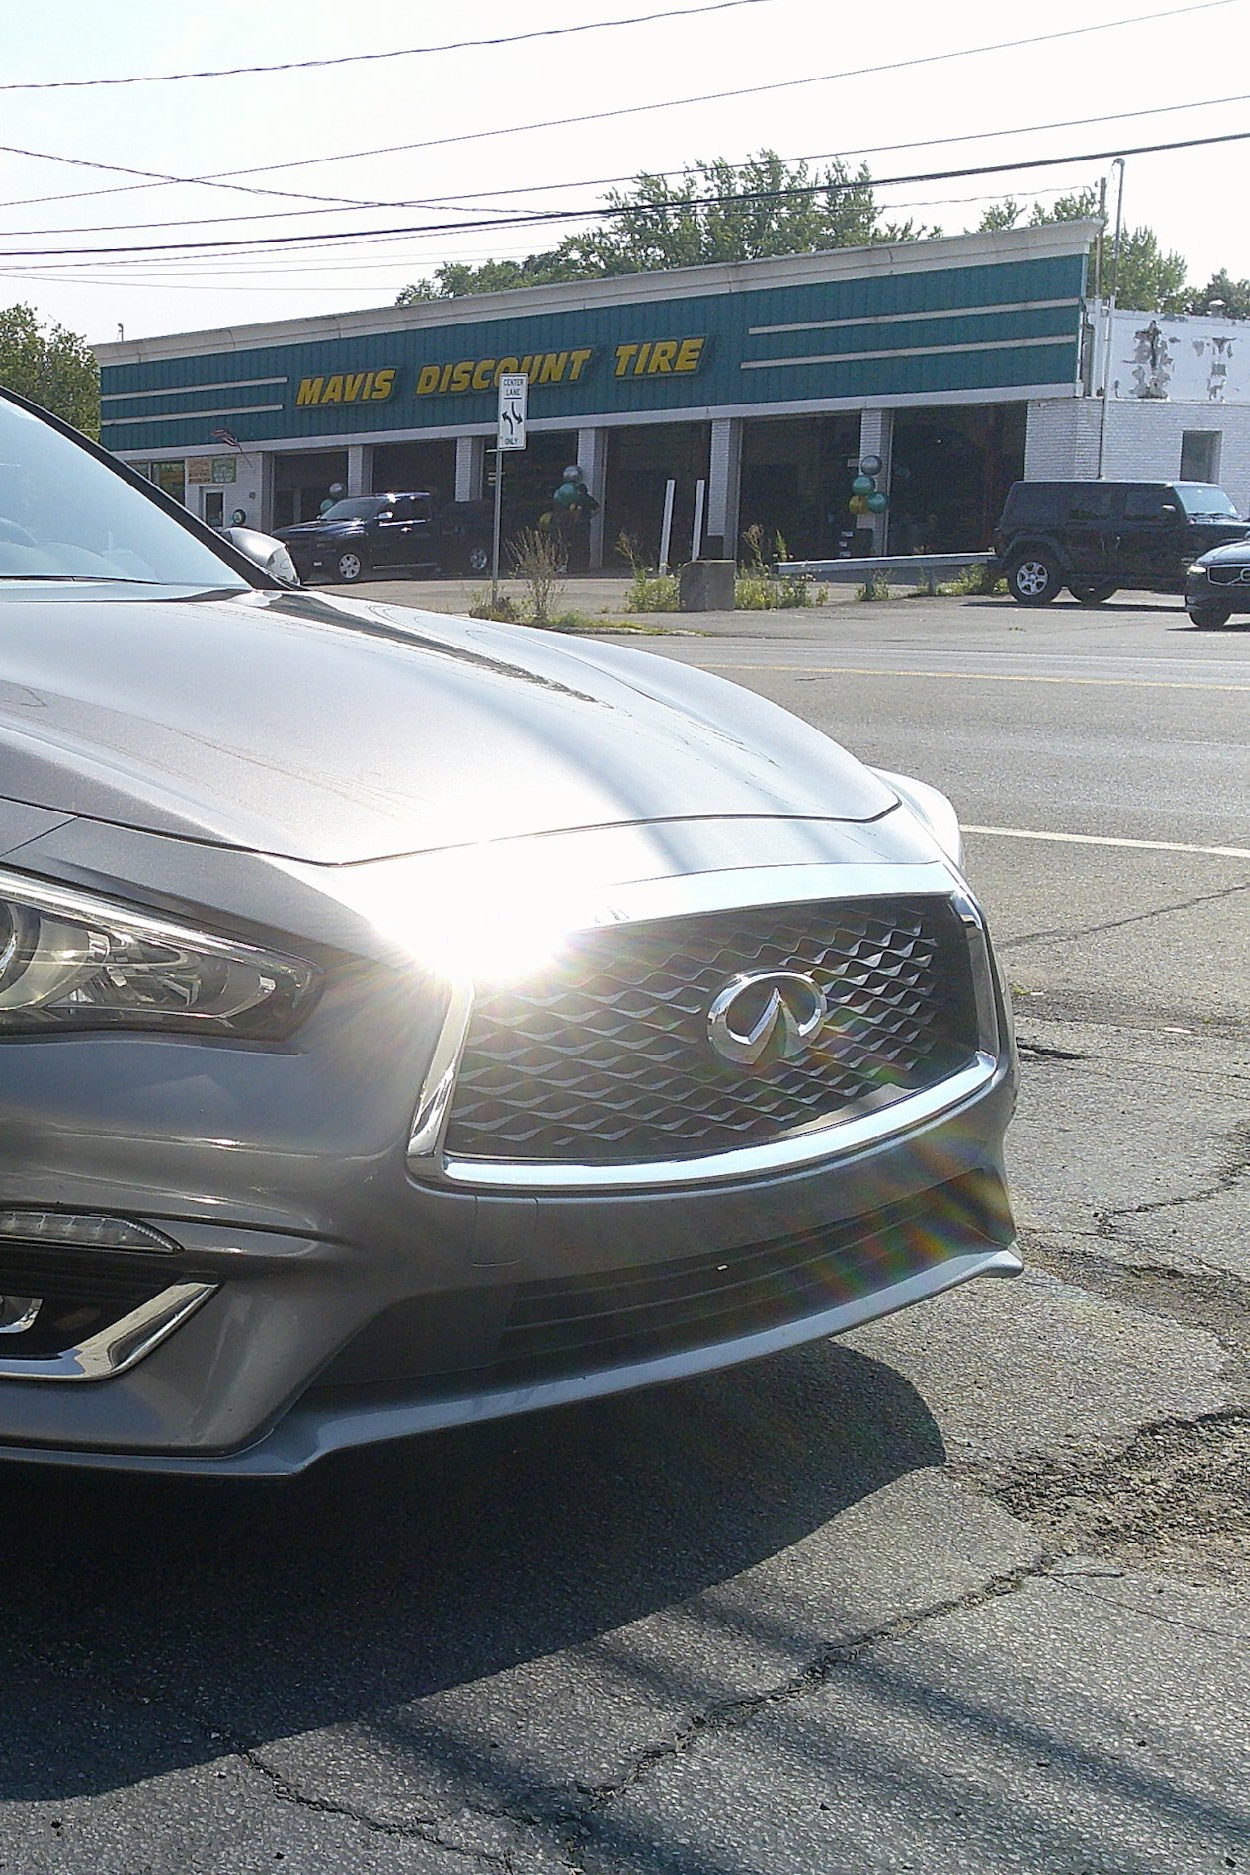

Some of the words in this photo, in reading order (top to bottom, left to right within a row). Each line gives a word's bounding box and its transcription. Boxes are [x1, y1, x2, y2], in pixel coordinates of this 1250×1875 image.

[296, 369, 395, 405] MAVIS
[416, 349, 592, 395] DISCOUNT
[614, 338, 704, 376] TIRE
[504, 379, 524, 387] CENTER
[506, 388, 521, 396] LANE
[504, 437, 518, 445] ONLY
